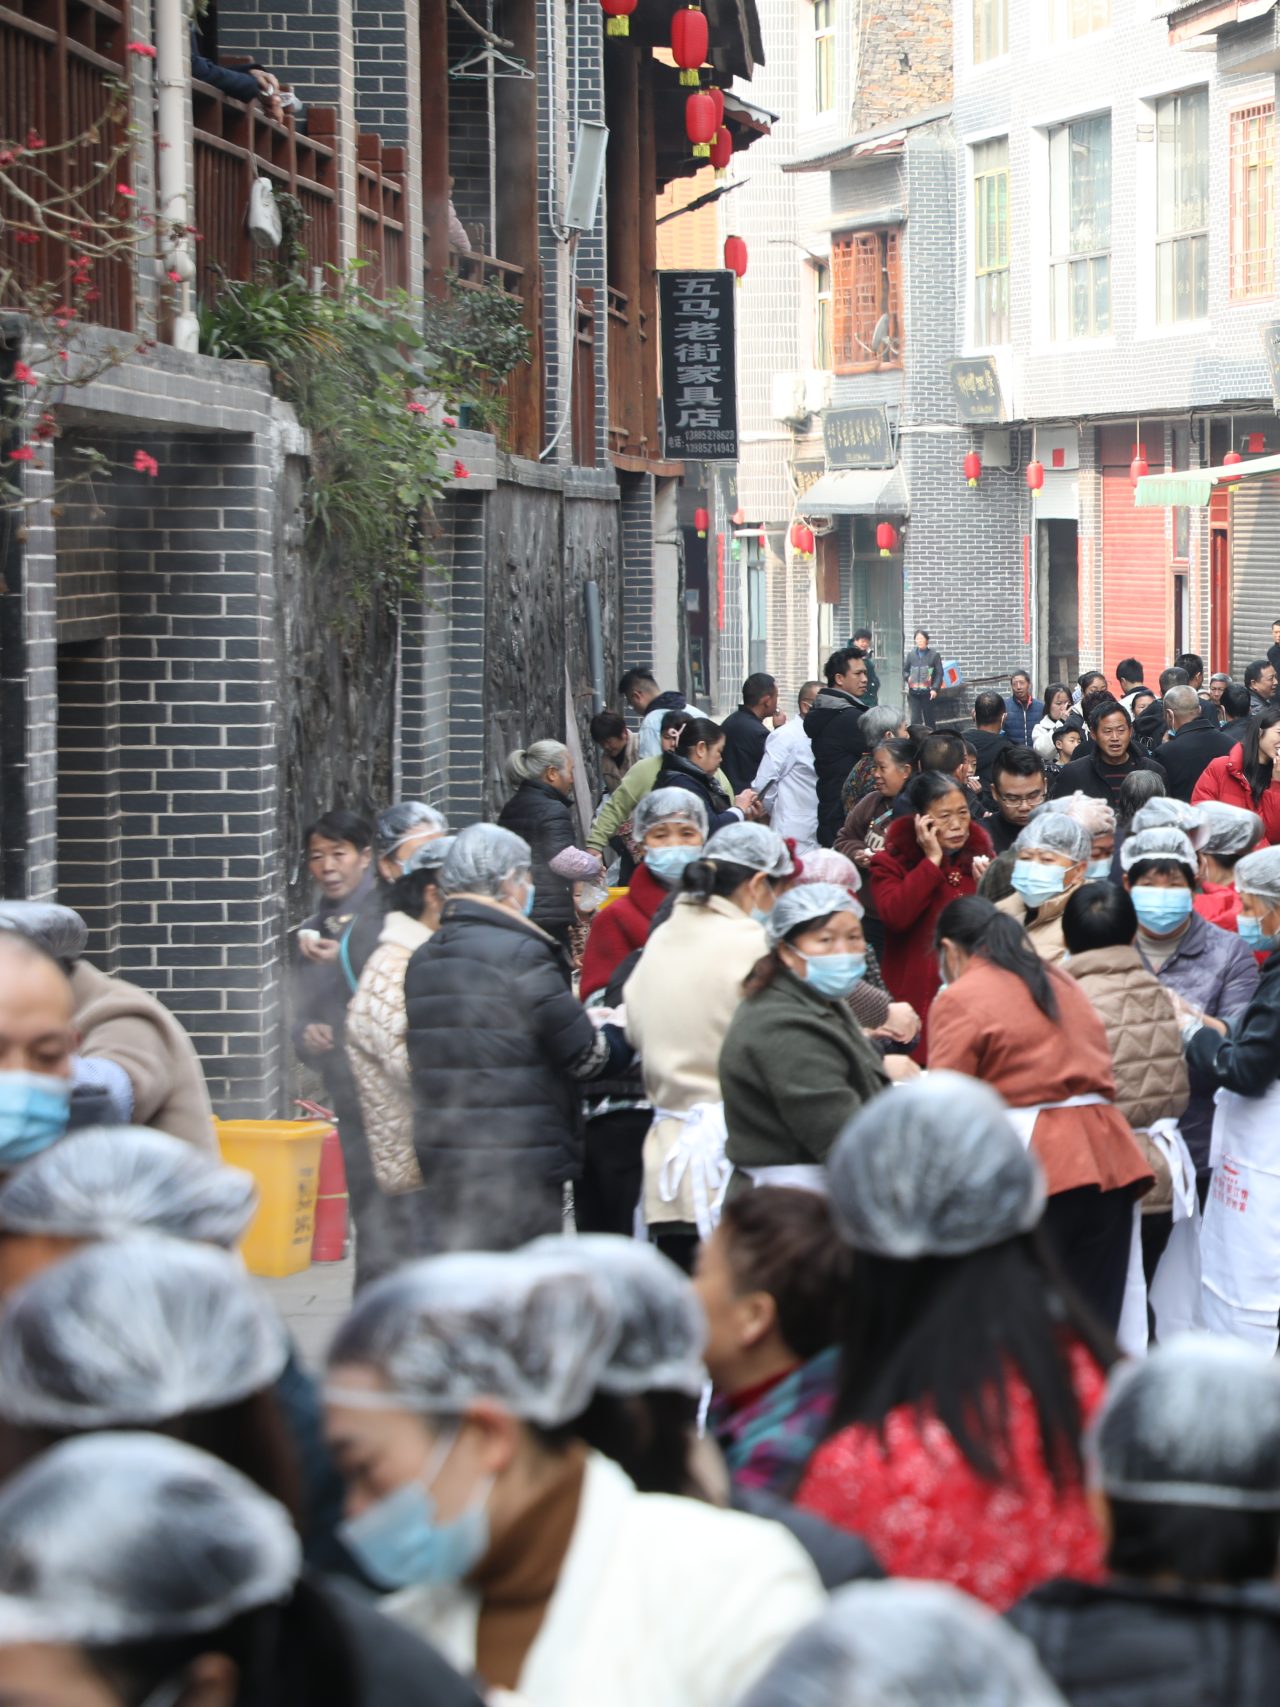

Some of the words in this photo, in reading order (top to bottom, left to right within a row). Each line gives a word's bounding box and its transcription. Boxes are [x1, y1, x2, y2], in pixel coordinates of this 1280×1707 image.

[672, 278, 722, 428] 五马老街家具店
